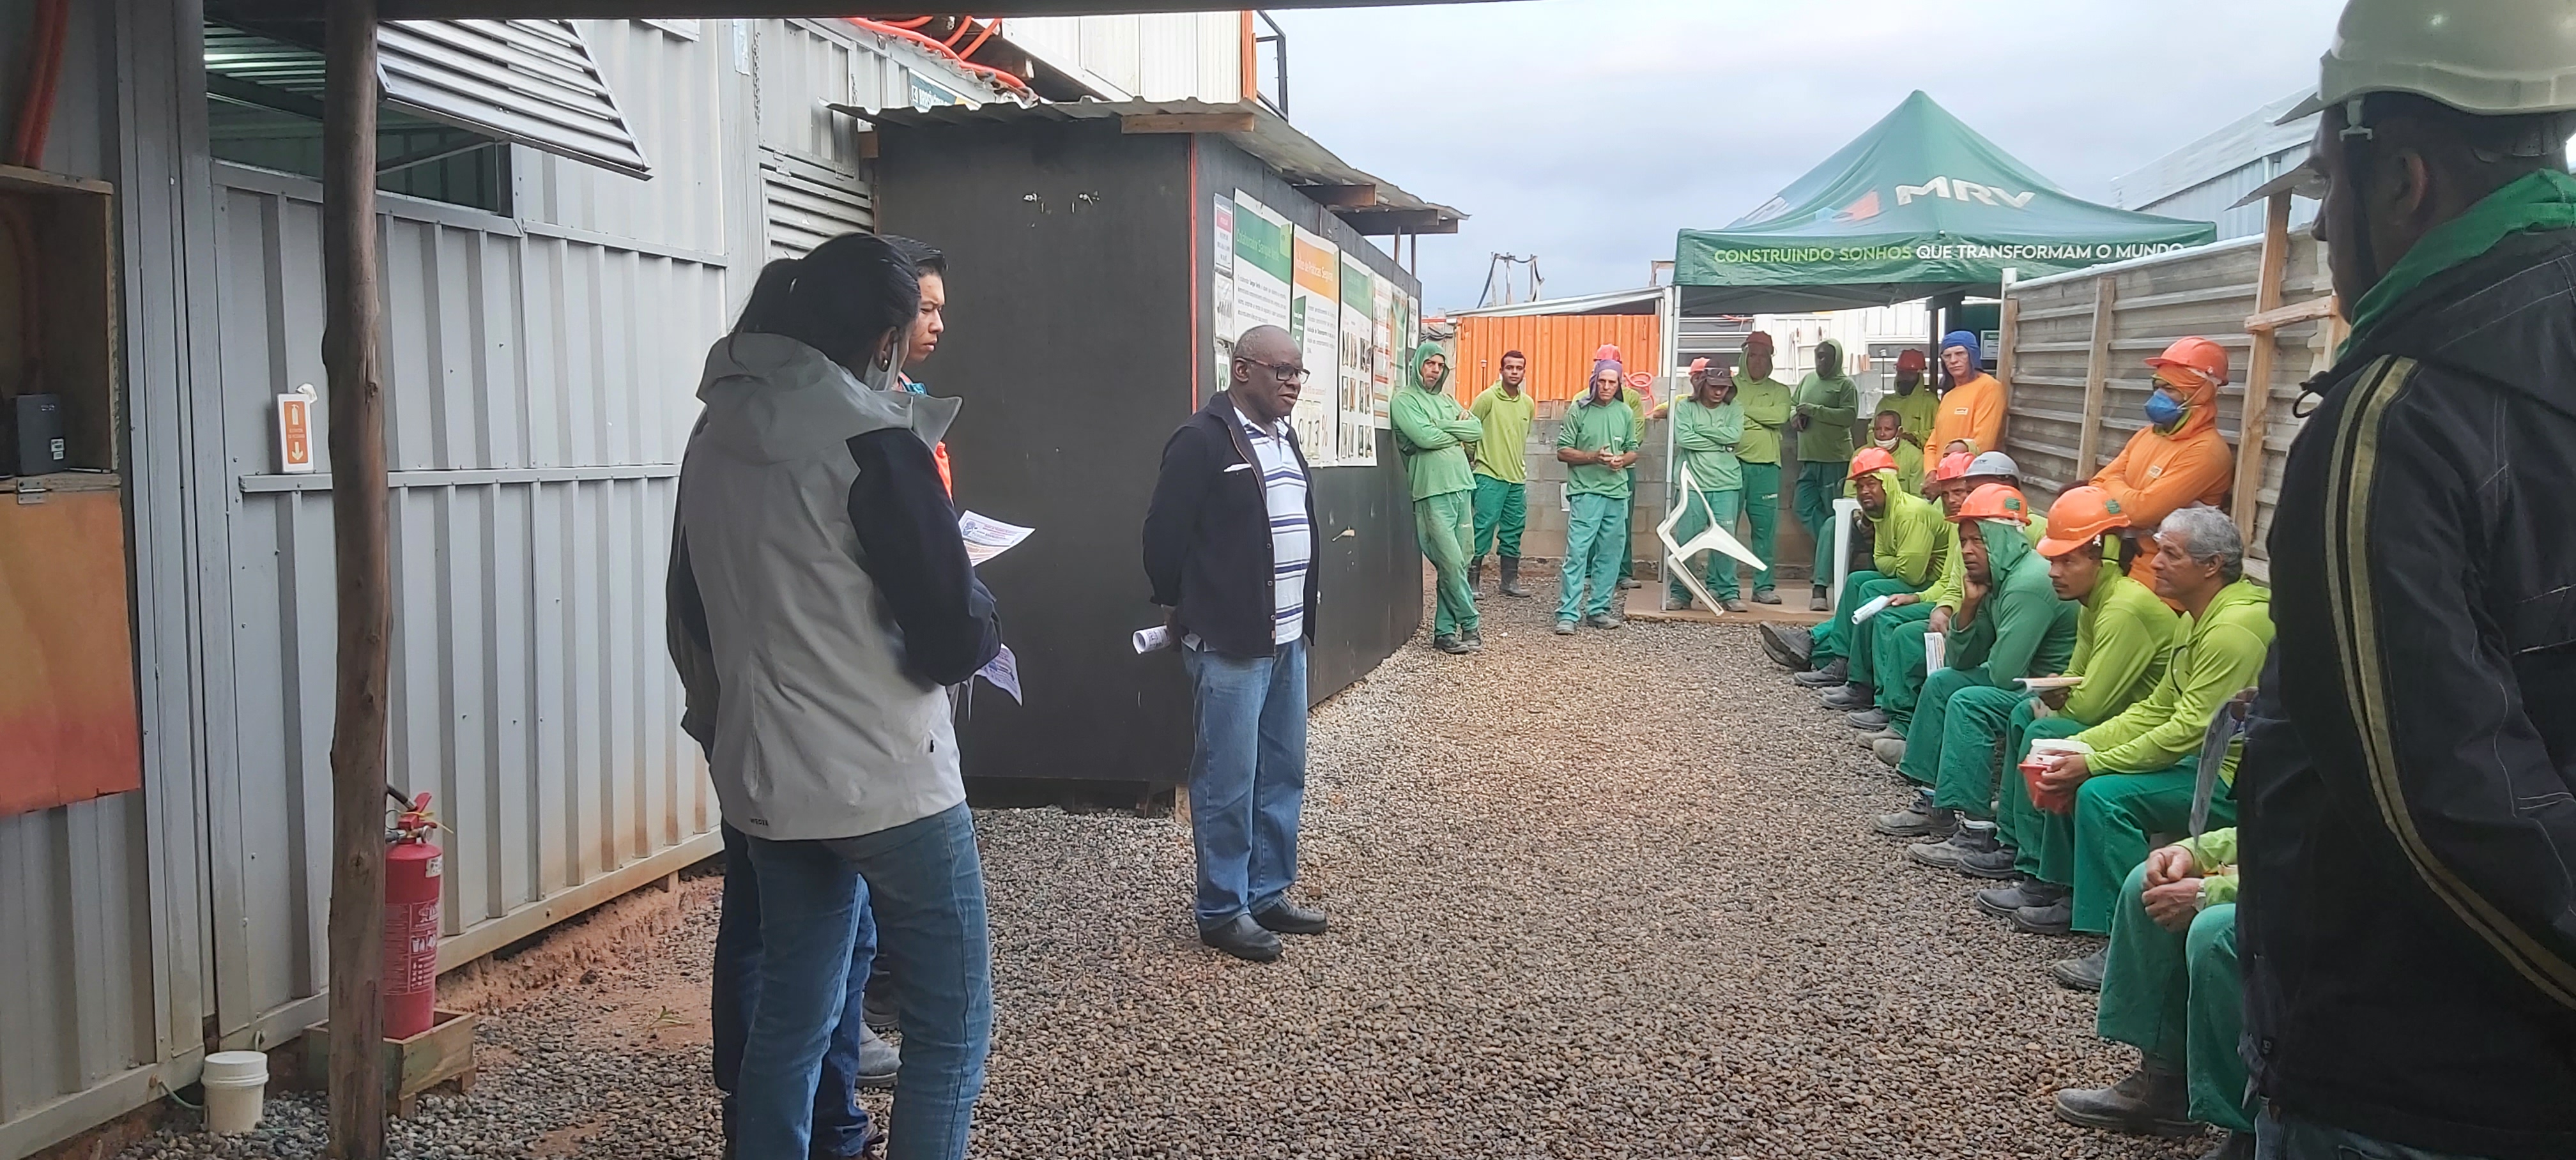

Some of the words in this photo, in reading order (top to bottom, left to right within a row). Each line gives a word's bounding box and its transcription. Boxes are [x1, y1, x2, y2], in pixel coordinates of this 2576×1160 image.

[1896, 176, 2035, 208] MRV
[1714, 247, 1834, 263] CONSTRUINDO
[1839, 245, 1912, 261] SONHOS
[1916, 245, 1952, 259] QUE
[1957, 244, 2091, 259] TRANSFORMAM
[2096, 244, 2112, 259] O
